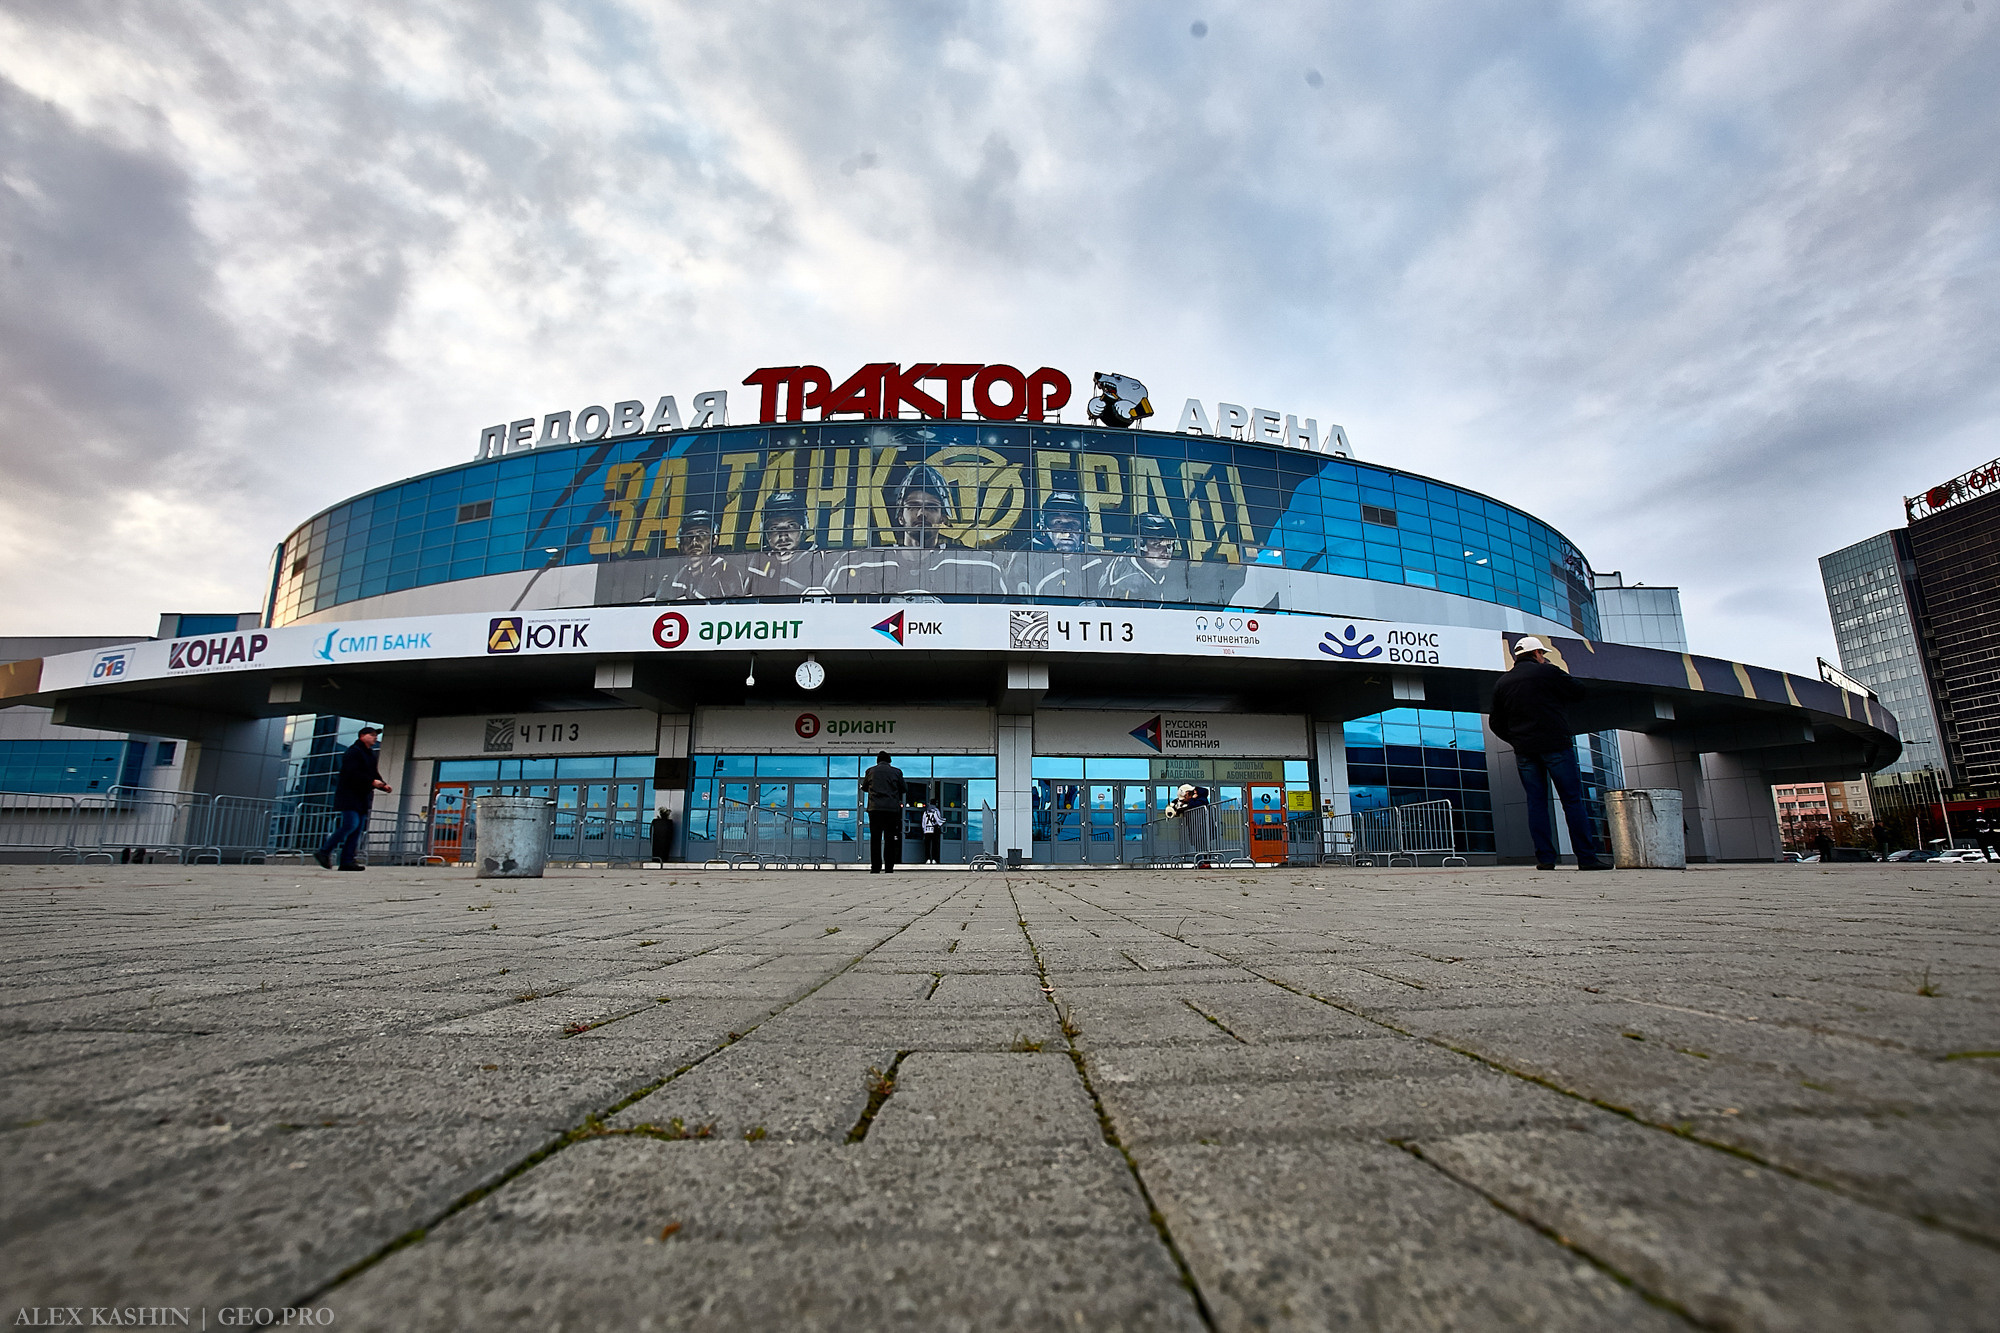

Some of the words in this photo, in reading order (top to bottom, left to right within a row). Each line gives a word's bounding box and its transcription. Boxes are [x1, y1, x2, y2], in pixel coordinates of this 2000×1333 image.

[742, 363, 1071, 423] ТРАКТОР
[474, 390, 728, 459] ЛЕДОВАЯ
[1176, 398, 1355, 458] АРЕНА
[590, 457, 689, 557] ЗА
[526, 624, 589, 649] ЮГК
[699, 620, 803, 645] ариант
[908, 622, 942, 635] РМК
[339, 635, 378, 653] СМП
[382, 632, 433, 650] БАНК
[168, 634, 268, 669] КОНАР
[826, 720, 896, 737] ариант
[1165, 720, 1208, 729] РУССКАЯ
[1165, 730, 1207, 739] МЕДНАЯ
[1165, 739, 1220, 749] КОМПАНИЯ
[1165, 760, 1184, 770] ВХОД
[1184, 760, 1200, 770] ДЛЯ
[1233, 761, 1265, 770] ЗОЛОТЫХ
[1160, 769, 1205, 779] ВЛАДЕЛЬЦЕВ
[1226, 770, 1273, 780] АБОНЕМЕНТОВ
